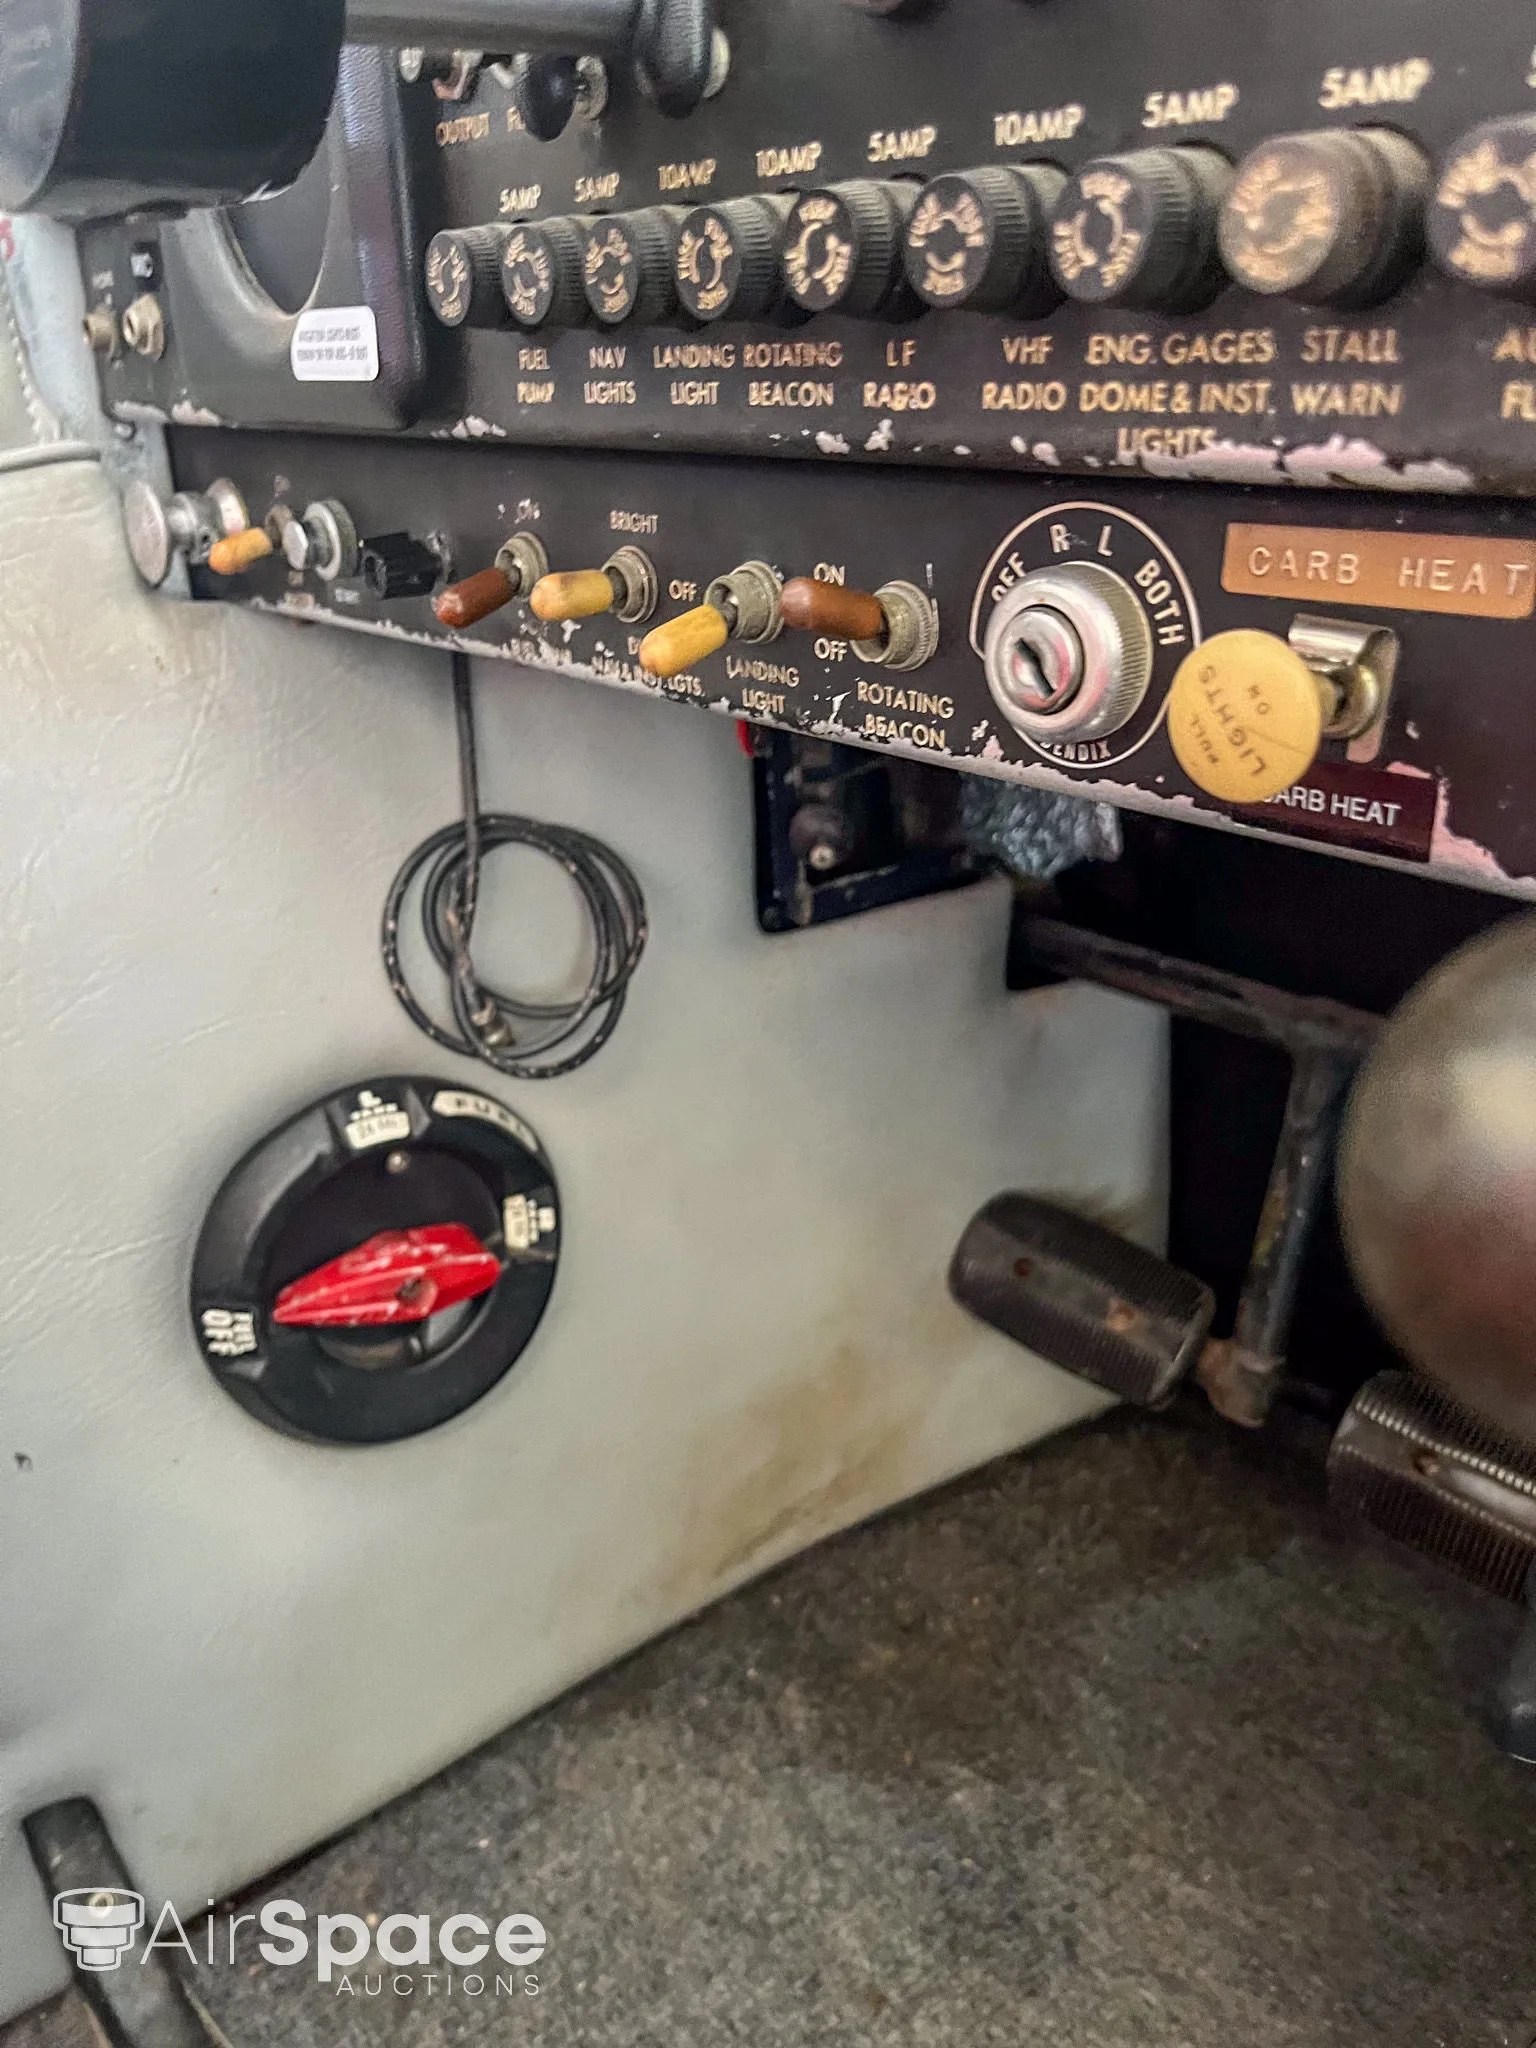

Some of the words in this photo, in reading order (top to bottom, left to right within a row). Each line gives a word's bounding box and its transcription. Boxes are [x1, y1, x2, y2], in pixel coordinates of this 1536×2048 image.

[993, 103, 1086, 147] 10AMP
[755, 141, 823, 177] 10AMP
[866, 125, 938, 163] 5AMP
[499, 183, 542, 214] 5AMP
[574, 172, 621, 203] 5AMP
[518, 348, 552, 371] FUEL
[589, 346, 627, 370] NAV
[652, 343, 736, 370] LANDING
[742, 341, 844, 369] ROTATING
[1002, 335, 1055, 366] VHF
[1161, 328, 1278, 366] GAGES
[1300, 326, 1401, 364] STALL
[516, 381, 556, 405] PUMP
[583, 381, 637, 405] LIGHTS
[669, 381, 721, 406] LIGHT
[747, 381, 835, 408] BEACON
[981, 381, 1069, 412] RADIO
[1078, 380, 1170, 414] DOME
[1289, 380, 1404, 416] WARN
[1115, 426, 1217, 462] LIGHTS
[609, 509, 659, 534] BRIGHT
[1049, 522, 1072, 553] R
[1097, 524, 1114, 557] L
[813, 562, 846, 586] ON
[1248, 544, 1361, 585] CARB
[1399, 557, 1530, 597] HEAT
[668, 578, 700, 602] OFF
[1133, 558, 1187, 646] BOTH
[813, 636, 848, 662] OFF
[726, 655, 800, 688] LANDING
[741, 688, 786, 714] LIGHT
[857, 680, 955, 719] ROTATING
[864, 713, 946, 749] BEACON
[1199, 663, 1267, 776] LIGHTS
[1264, 785, 1326, 814] ARB
[1331, 793, 1402, 828] HEAT
